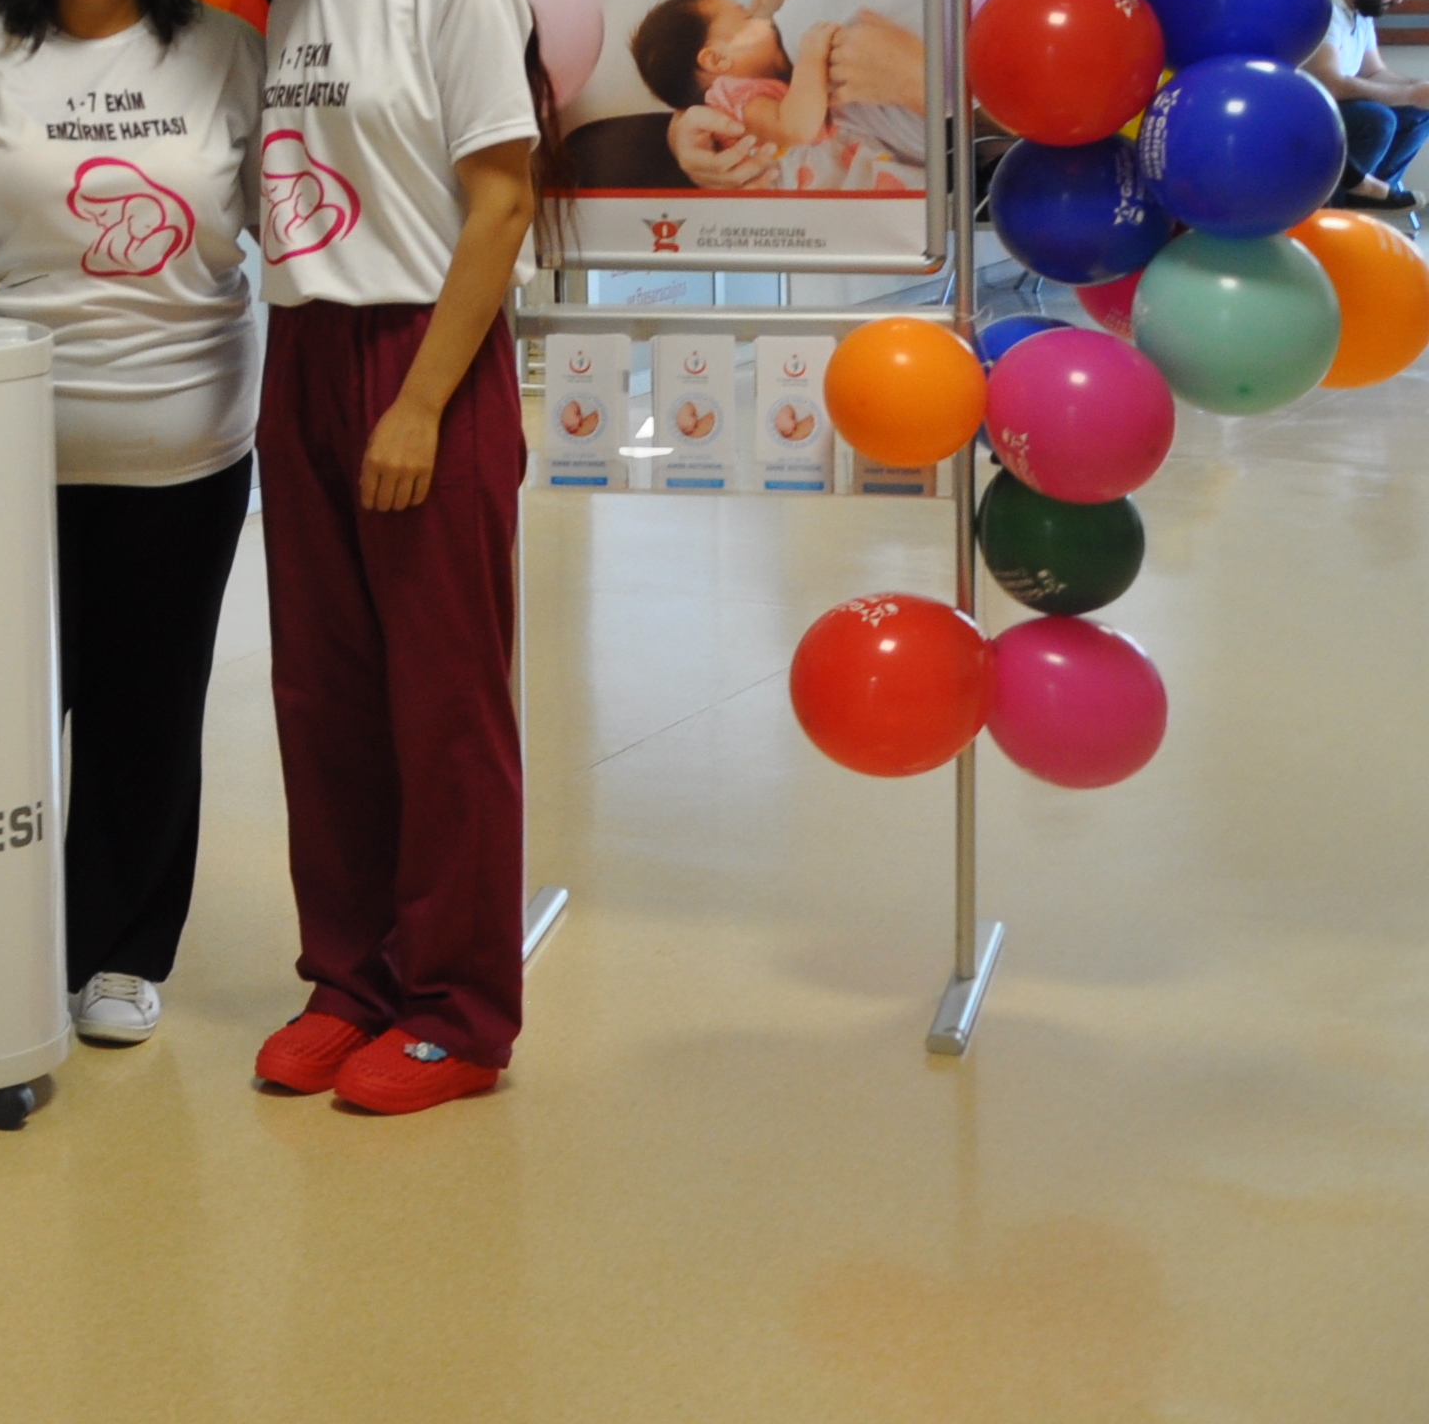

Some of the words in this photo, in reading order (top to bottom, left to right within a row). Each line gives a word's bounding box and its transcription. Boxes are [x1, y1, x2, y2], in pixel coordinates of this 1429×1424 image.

[66, 97, 76, 112] 1
[87, 91, 97, 113] 7
[104, 88, 147, 113] EKİM
[46, 117, 118, 141] EMZİRME
[118, 115, 189, 141] HAFTASI
